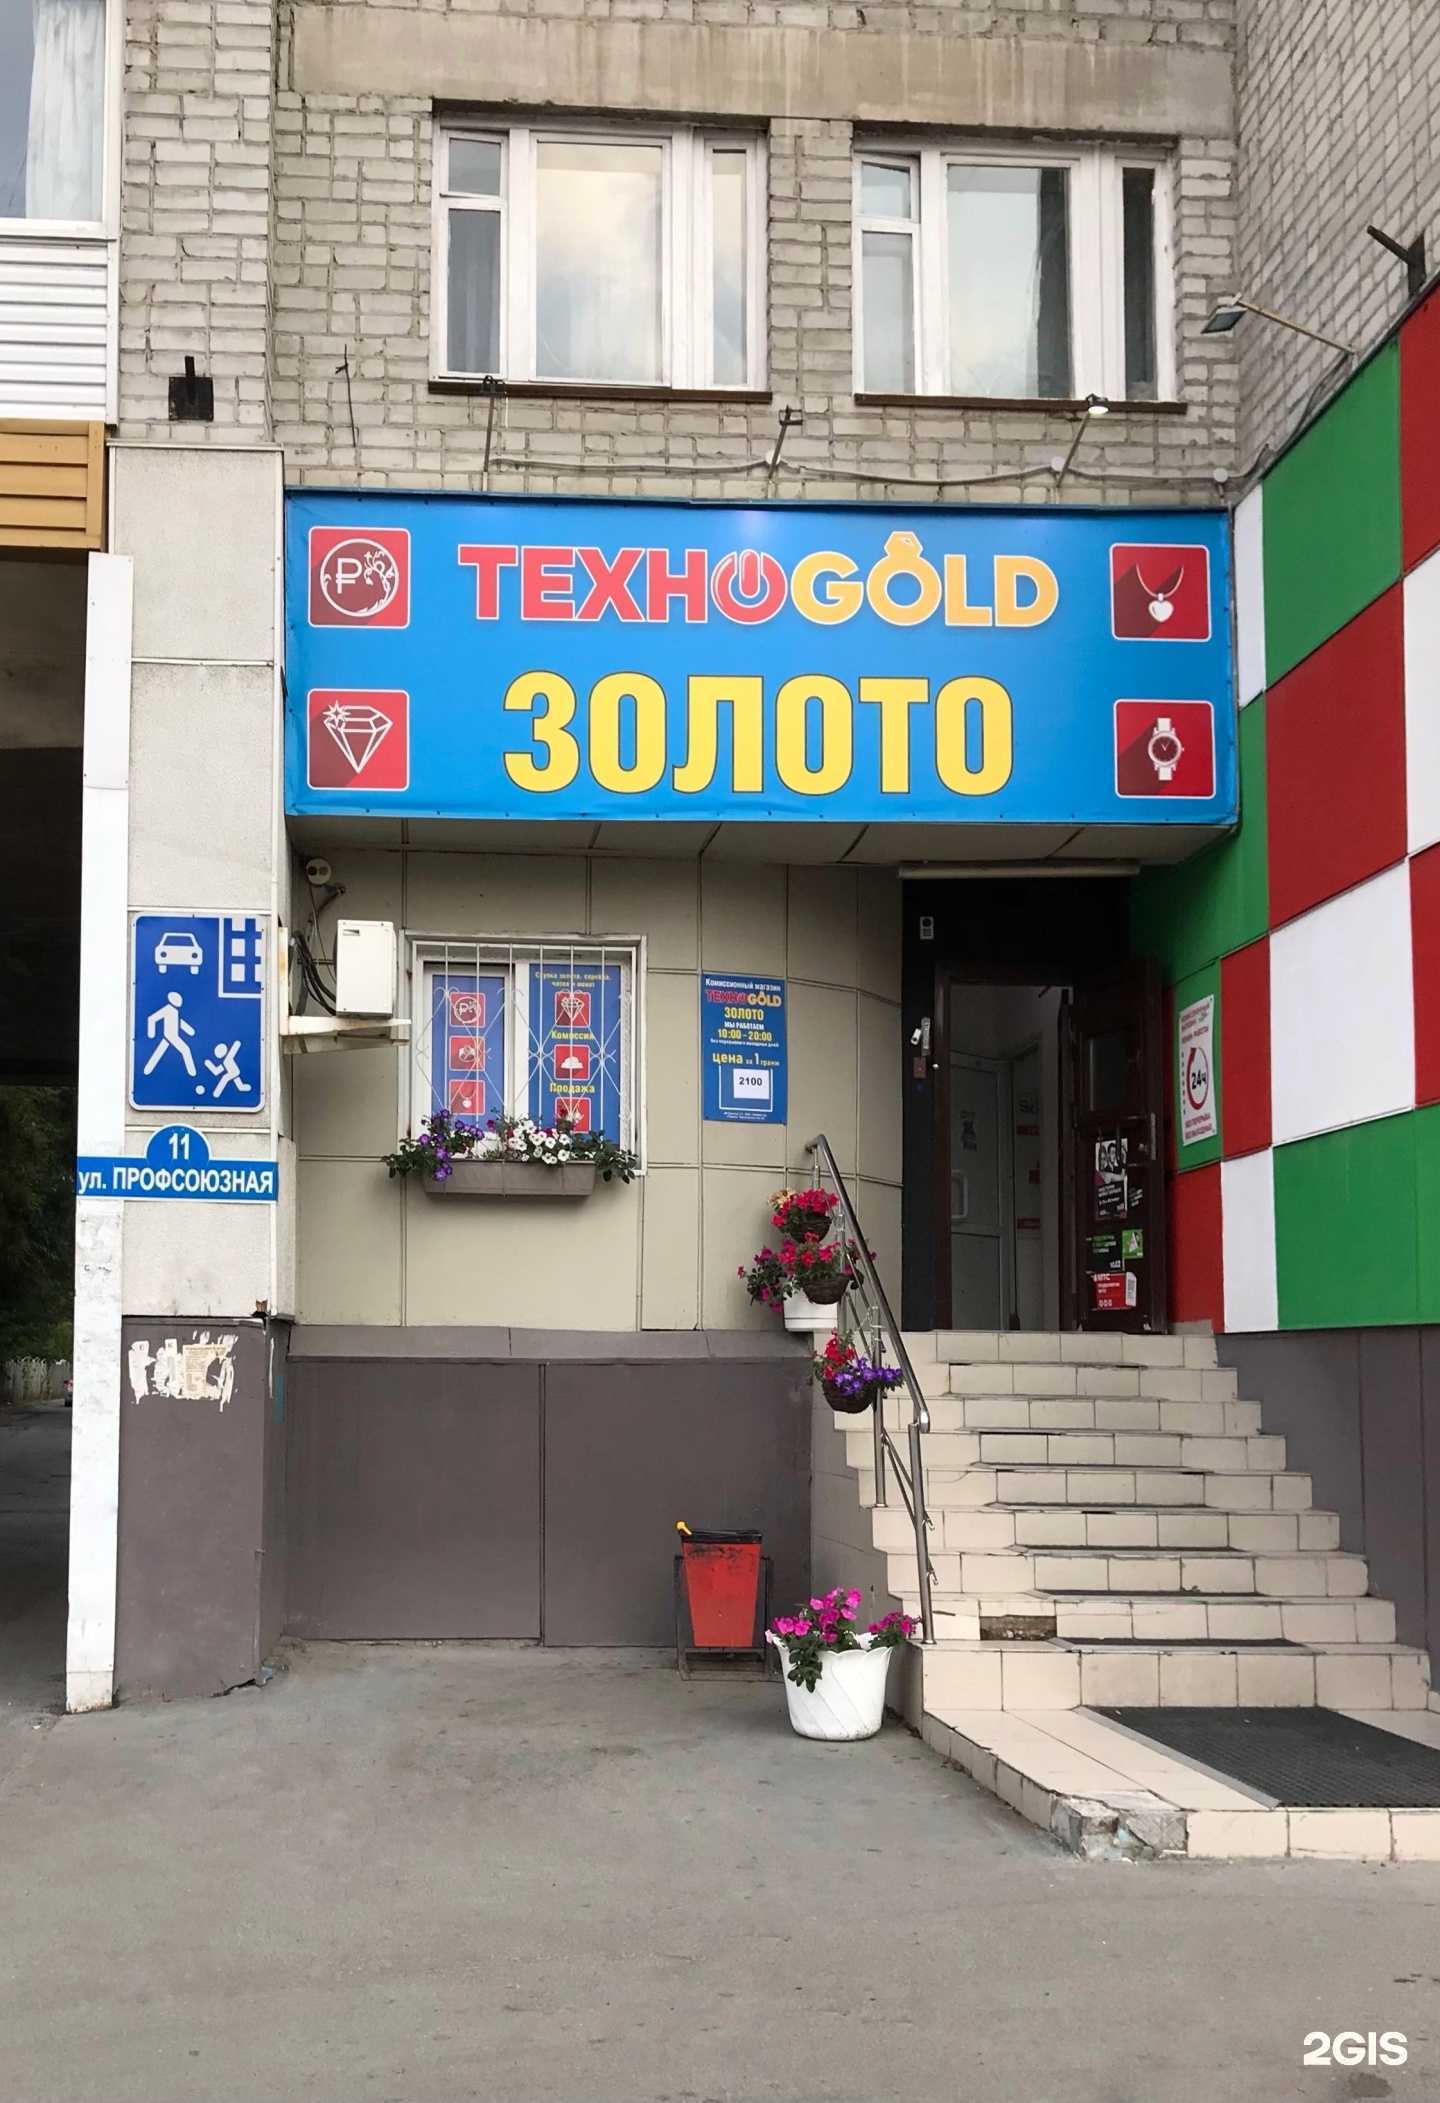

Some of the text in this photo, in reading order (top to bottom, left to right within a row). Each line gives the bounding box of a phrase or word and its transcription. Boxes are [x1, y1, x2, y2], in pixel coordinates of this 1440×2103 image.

[502, 669, 1015, 797] ЗОЛОТО
[724, 1007, 764, 1021] ЗОЛОТО
[718, 1028, 741, 1039] 10:00
[748, 1031, 772, 1041] 20:00
[712, 1052, 743, 1065] цена
[754, 1052, 759, 1065] 1
[550, 1082, 595, 1094] Продажа
[739, 1077, 763, 1086] 2100
[168, 1133, 191, 1160] 11
[78, 1167, 274, 1194] ул. ПРОФСОЮЗНАЯ
